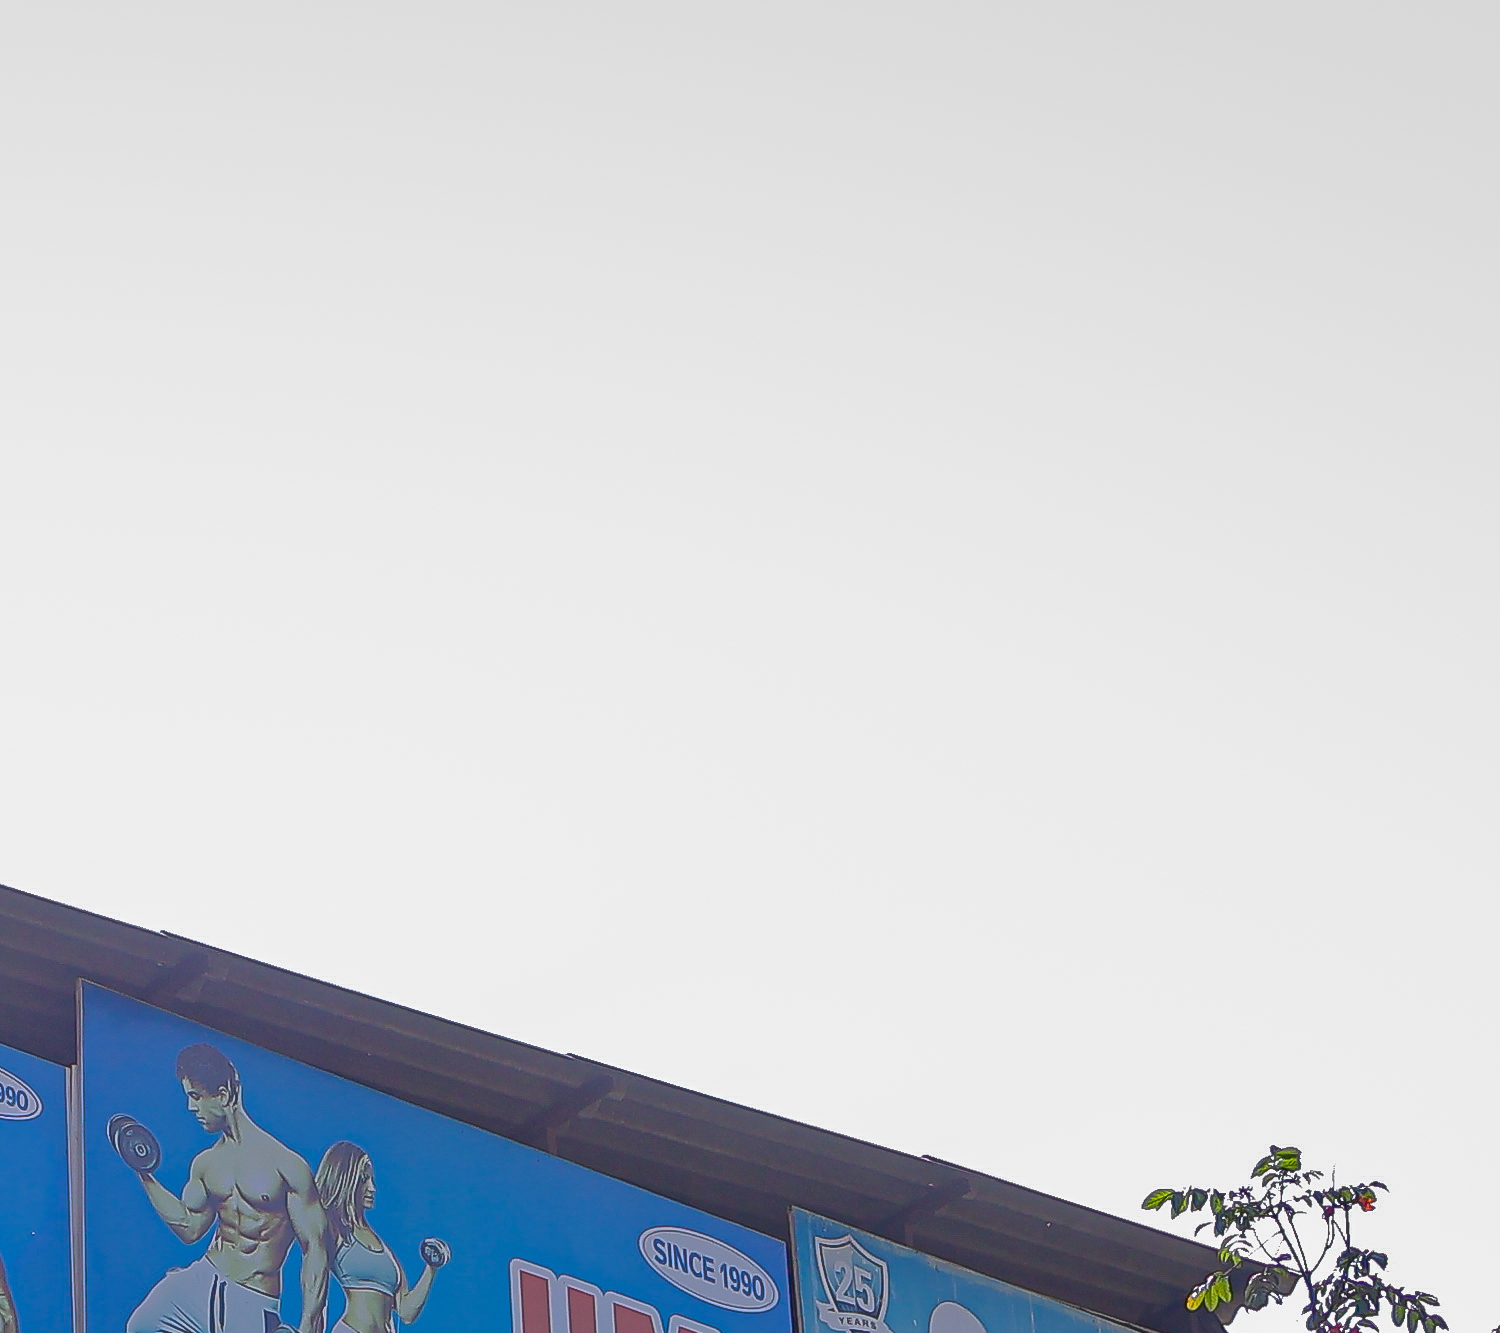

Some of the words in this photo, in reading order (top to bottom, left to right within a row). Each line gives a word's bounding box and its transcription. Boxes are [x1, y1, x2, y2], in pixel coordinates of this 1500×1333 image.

[651, 1241, 717, 1288] SINCE
[719, 1264, 766, 1303] 1990
[833, 1258, 876, 1314] 25
[838, 1314, 878, 1331] YEARS
